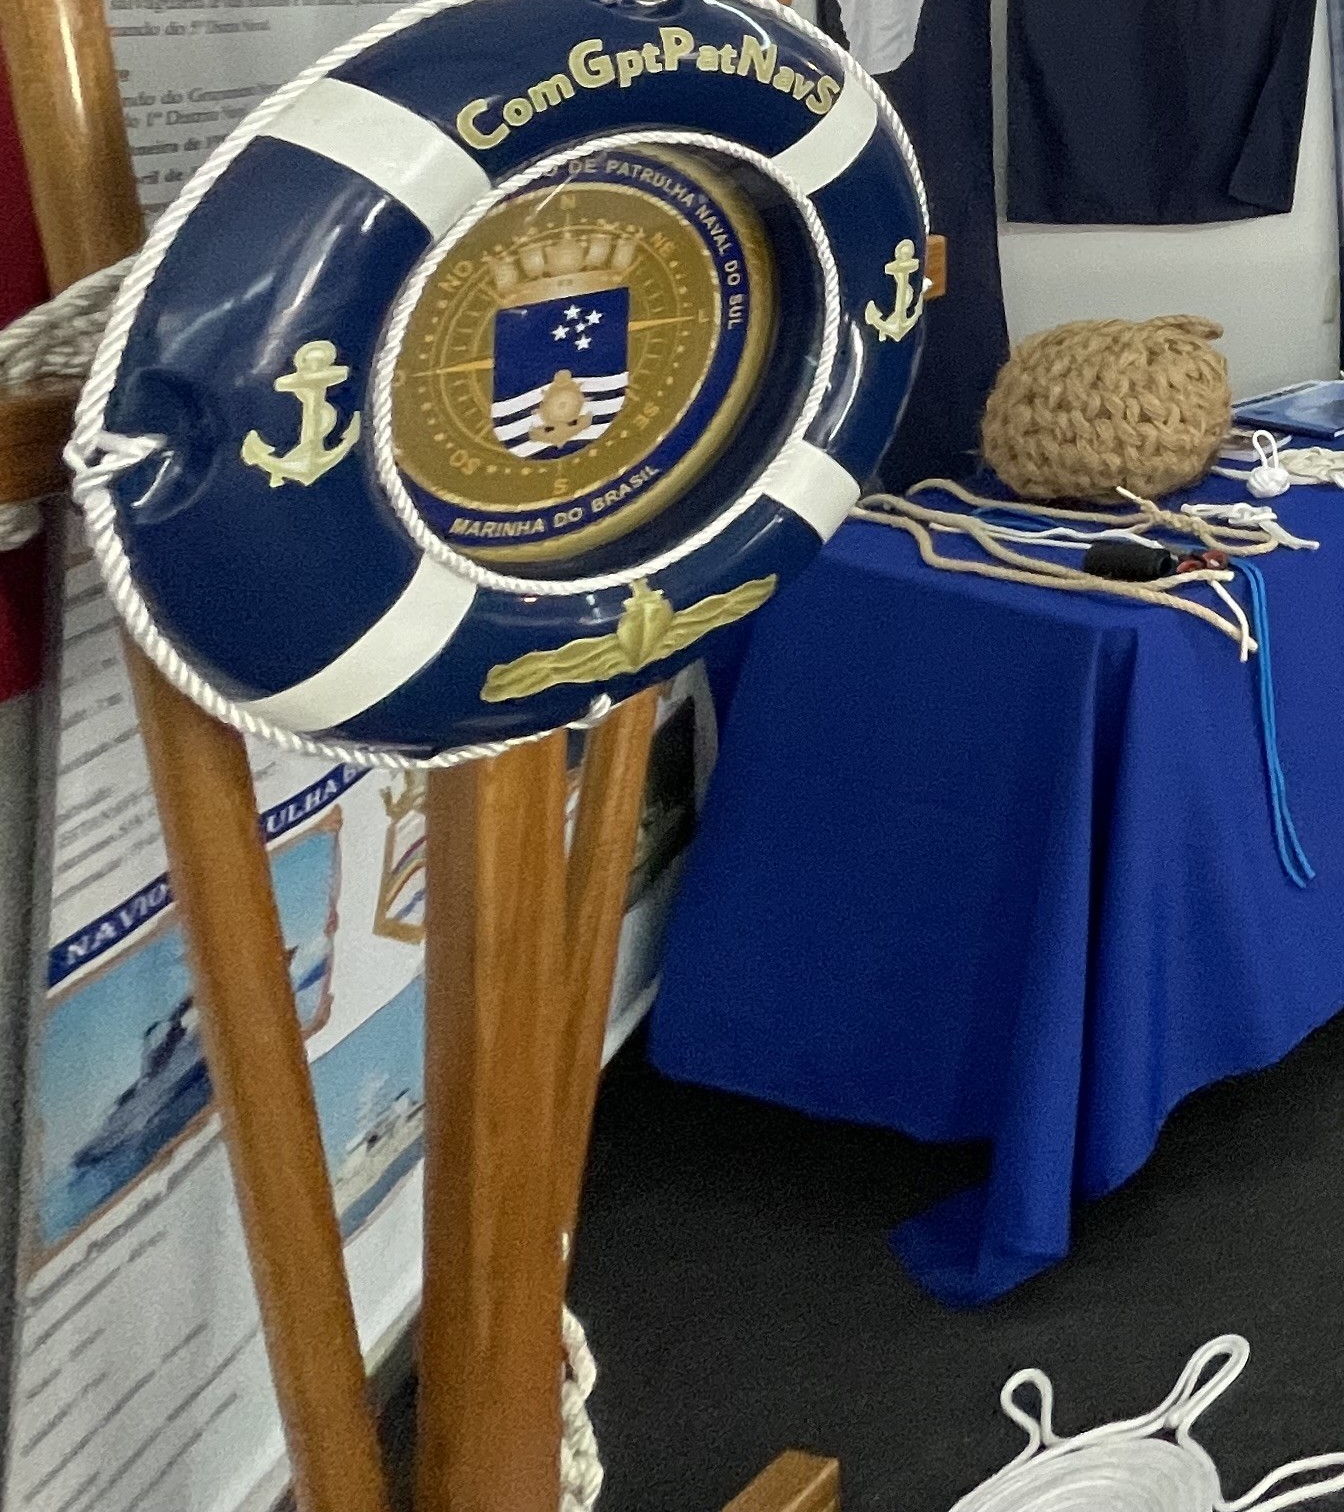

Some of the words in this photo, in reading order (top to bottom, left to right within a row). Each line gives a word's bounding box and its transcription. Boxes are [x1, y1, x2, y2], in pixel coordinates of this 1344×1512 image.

[455, 26, 841, 151] ComGptPatNavS
[568, 158, 599, 175] DE
[605, 158, 695, 208] PATRULHA
[695, 203, 734, 257] NAVAL
[724, 259, 741, 287] DO
[728, 292, 748, 331] SUL
[449, 517, 545, 538] MARINHA
[553, 507, 583, 528] DO
[591, 465, 660, 514] BRASIL
[265, 779, 339, 835] ULHA
